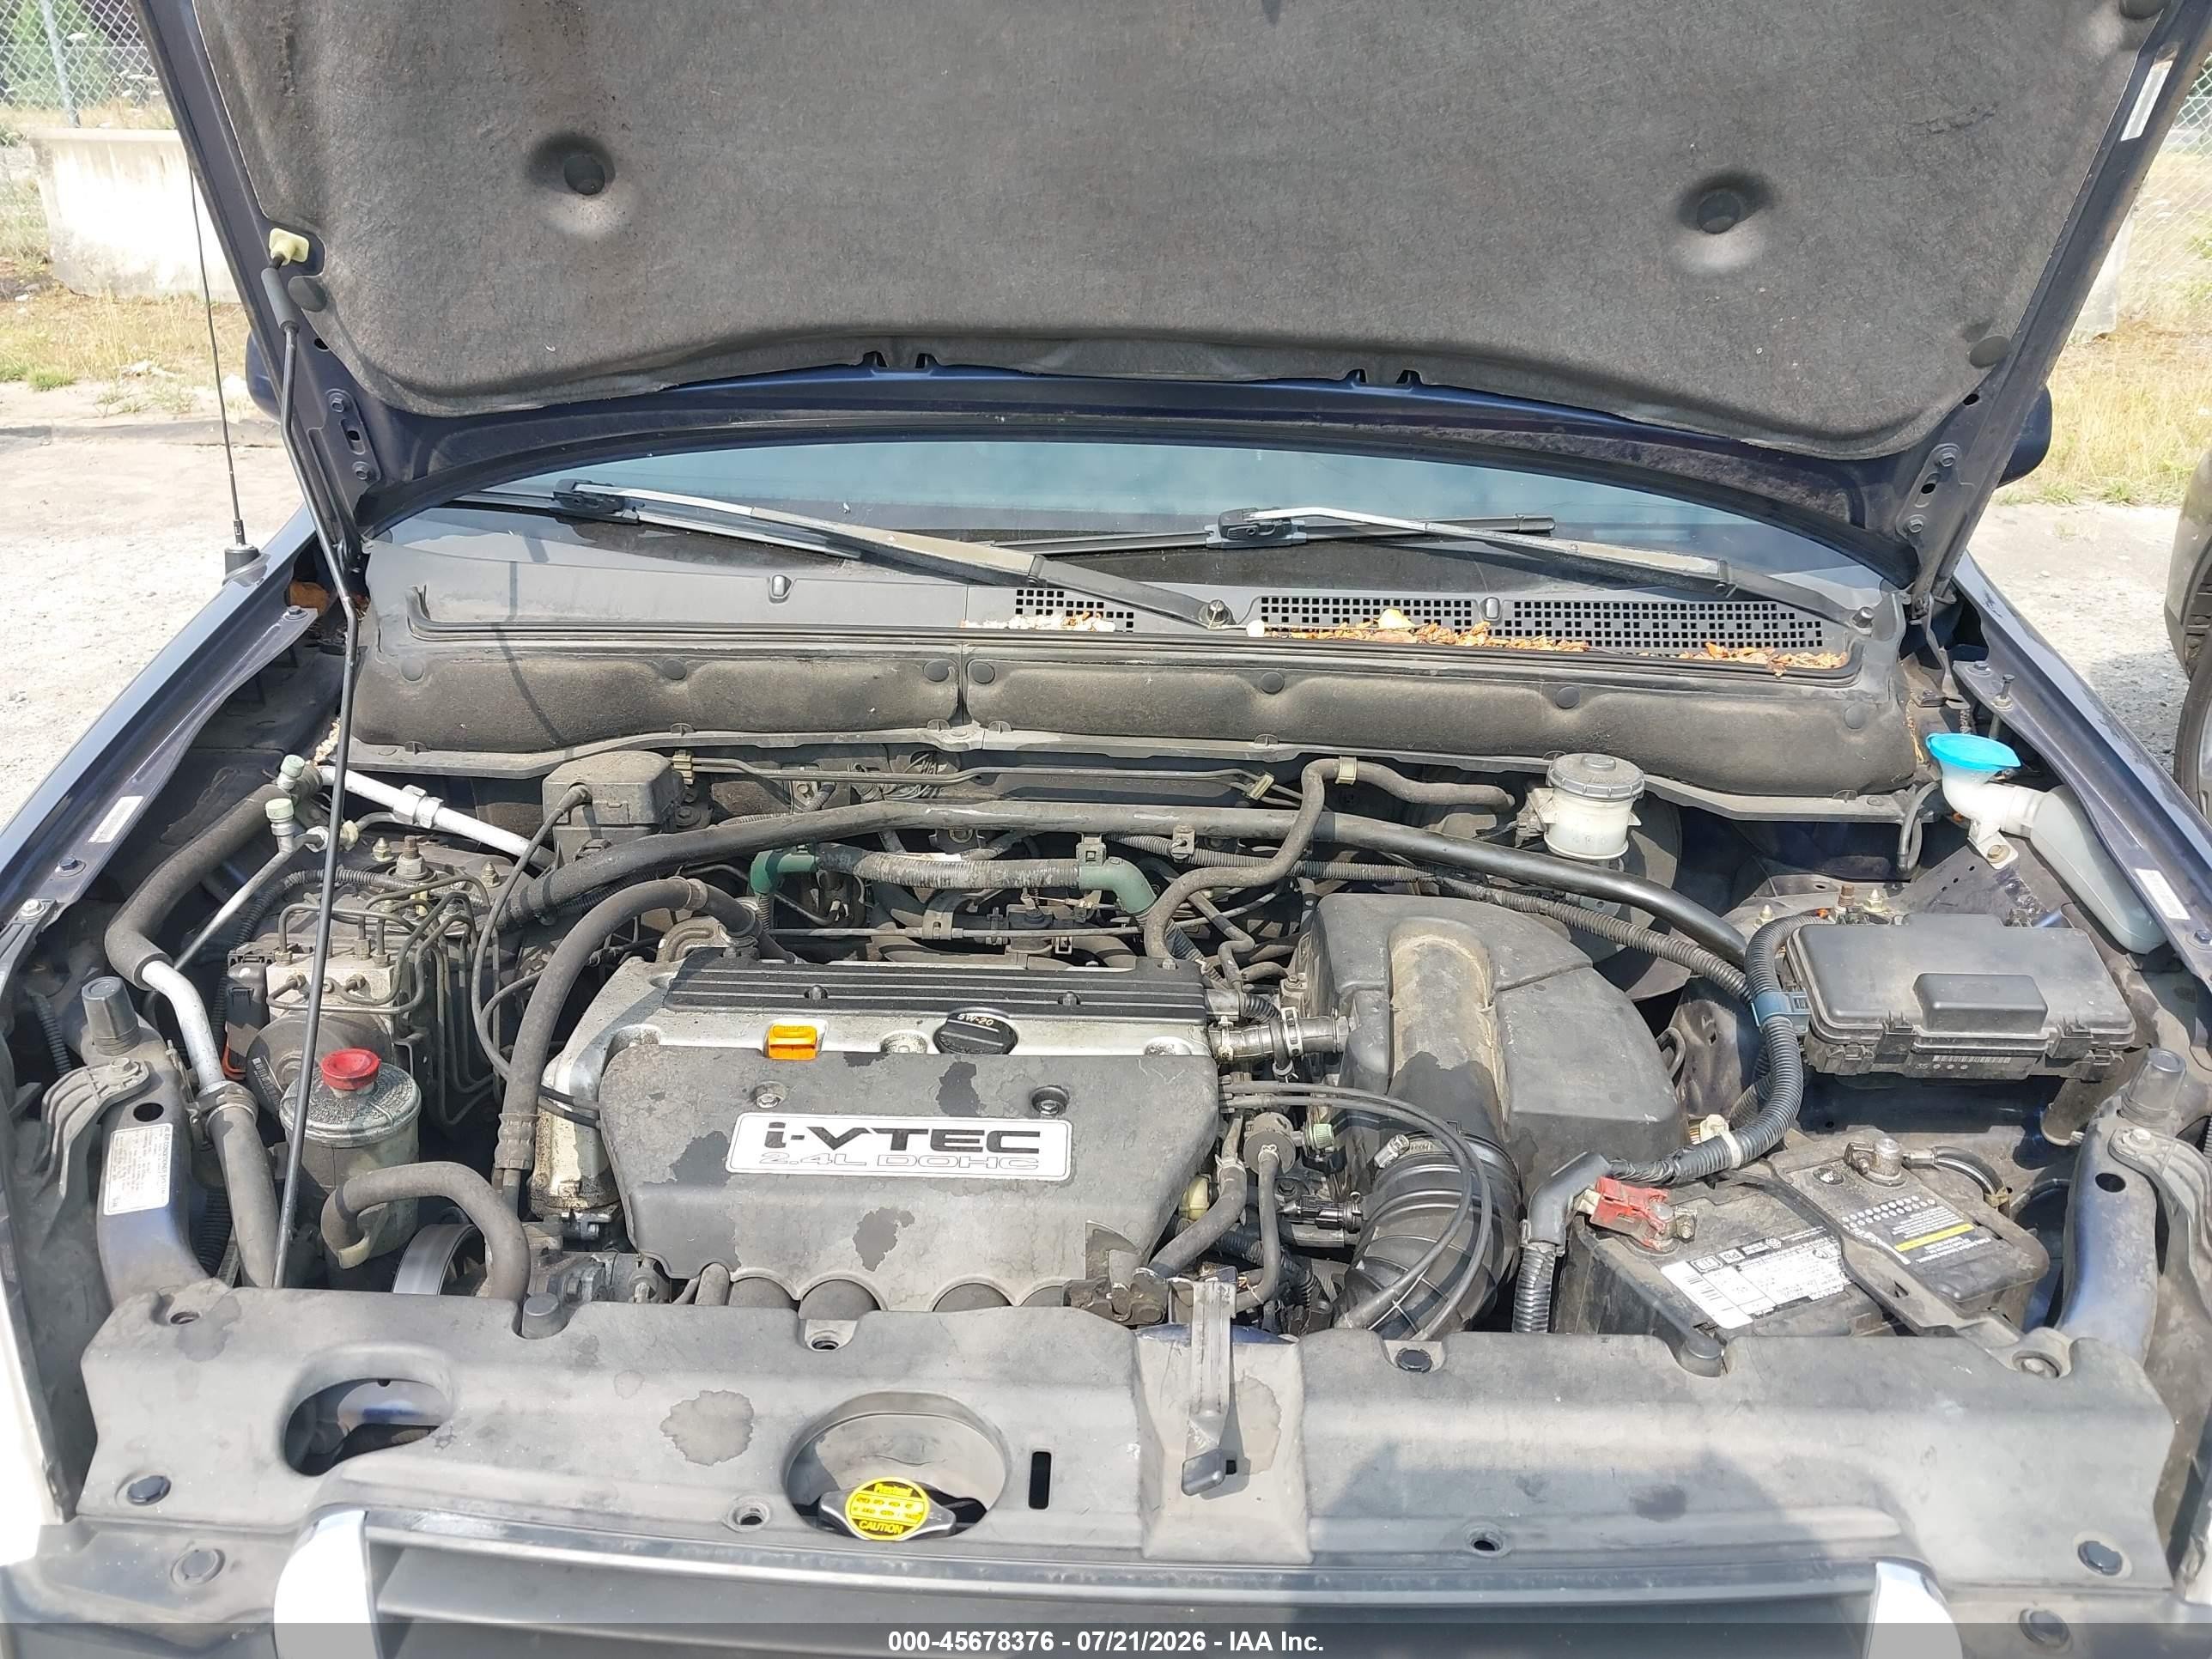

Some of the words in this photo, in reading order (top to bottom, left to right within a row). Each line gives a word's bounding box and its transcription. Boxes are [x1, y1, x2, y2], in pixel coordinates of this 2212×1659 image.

[957, 1013, 994, 1026] 5W-20
[764, 1121, 1041, 1153] i-VTEC
[759, 1152, 866, 1166] 2.4L
[877, 1154, 1039, 1170] DOHC
[859, 1520, 904, 1534] CAUTION
